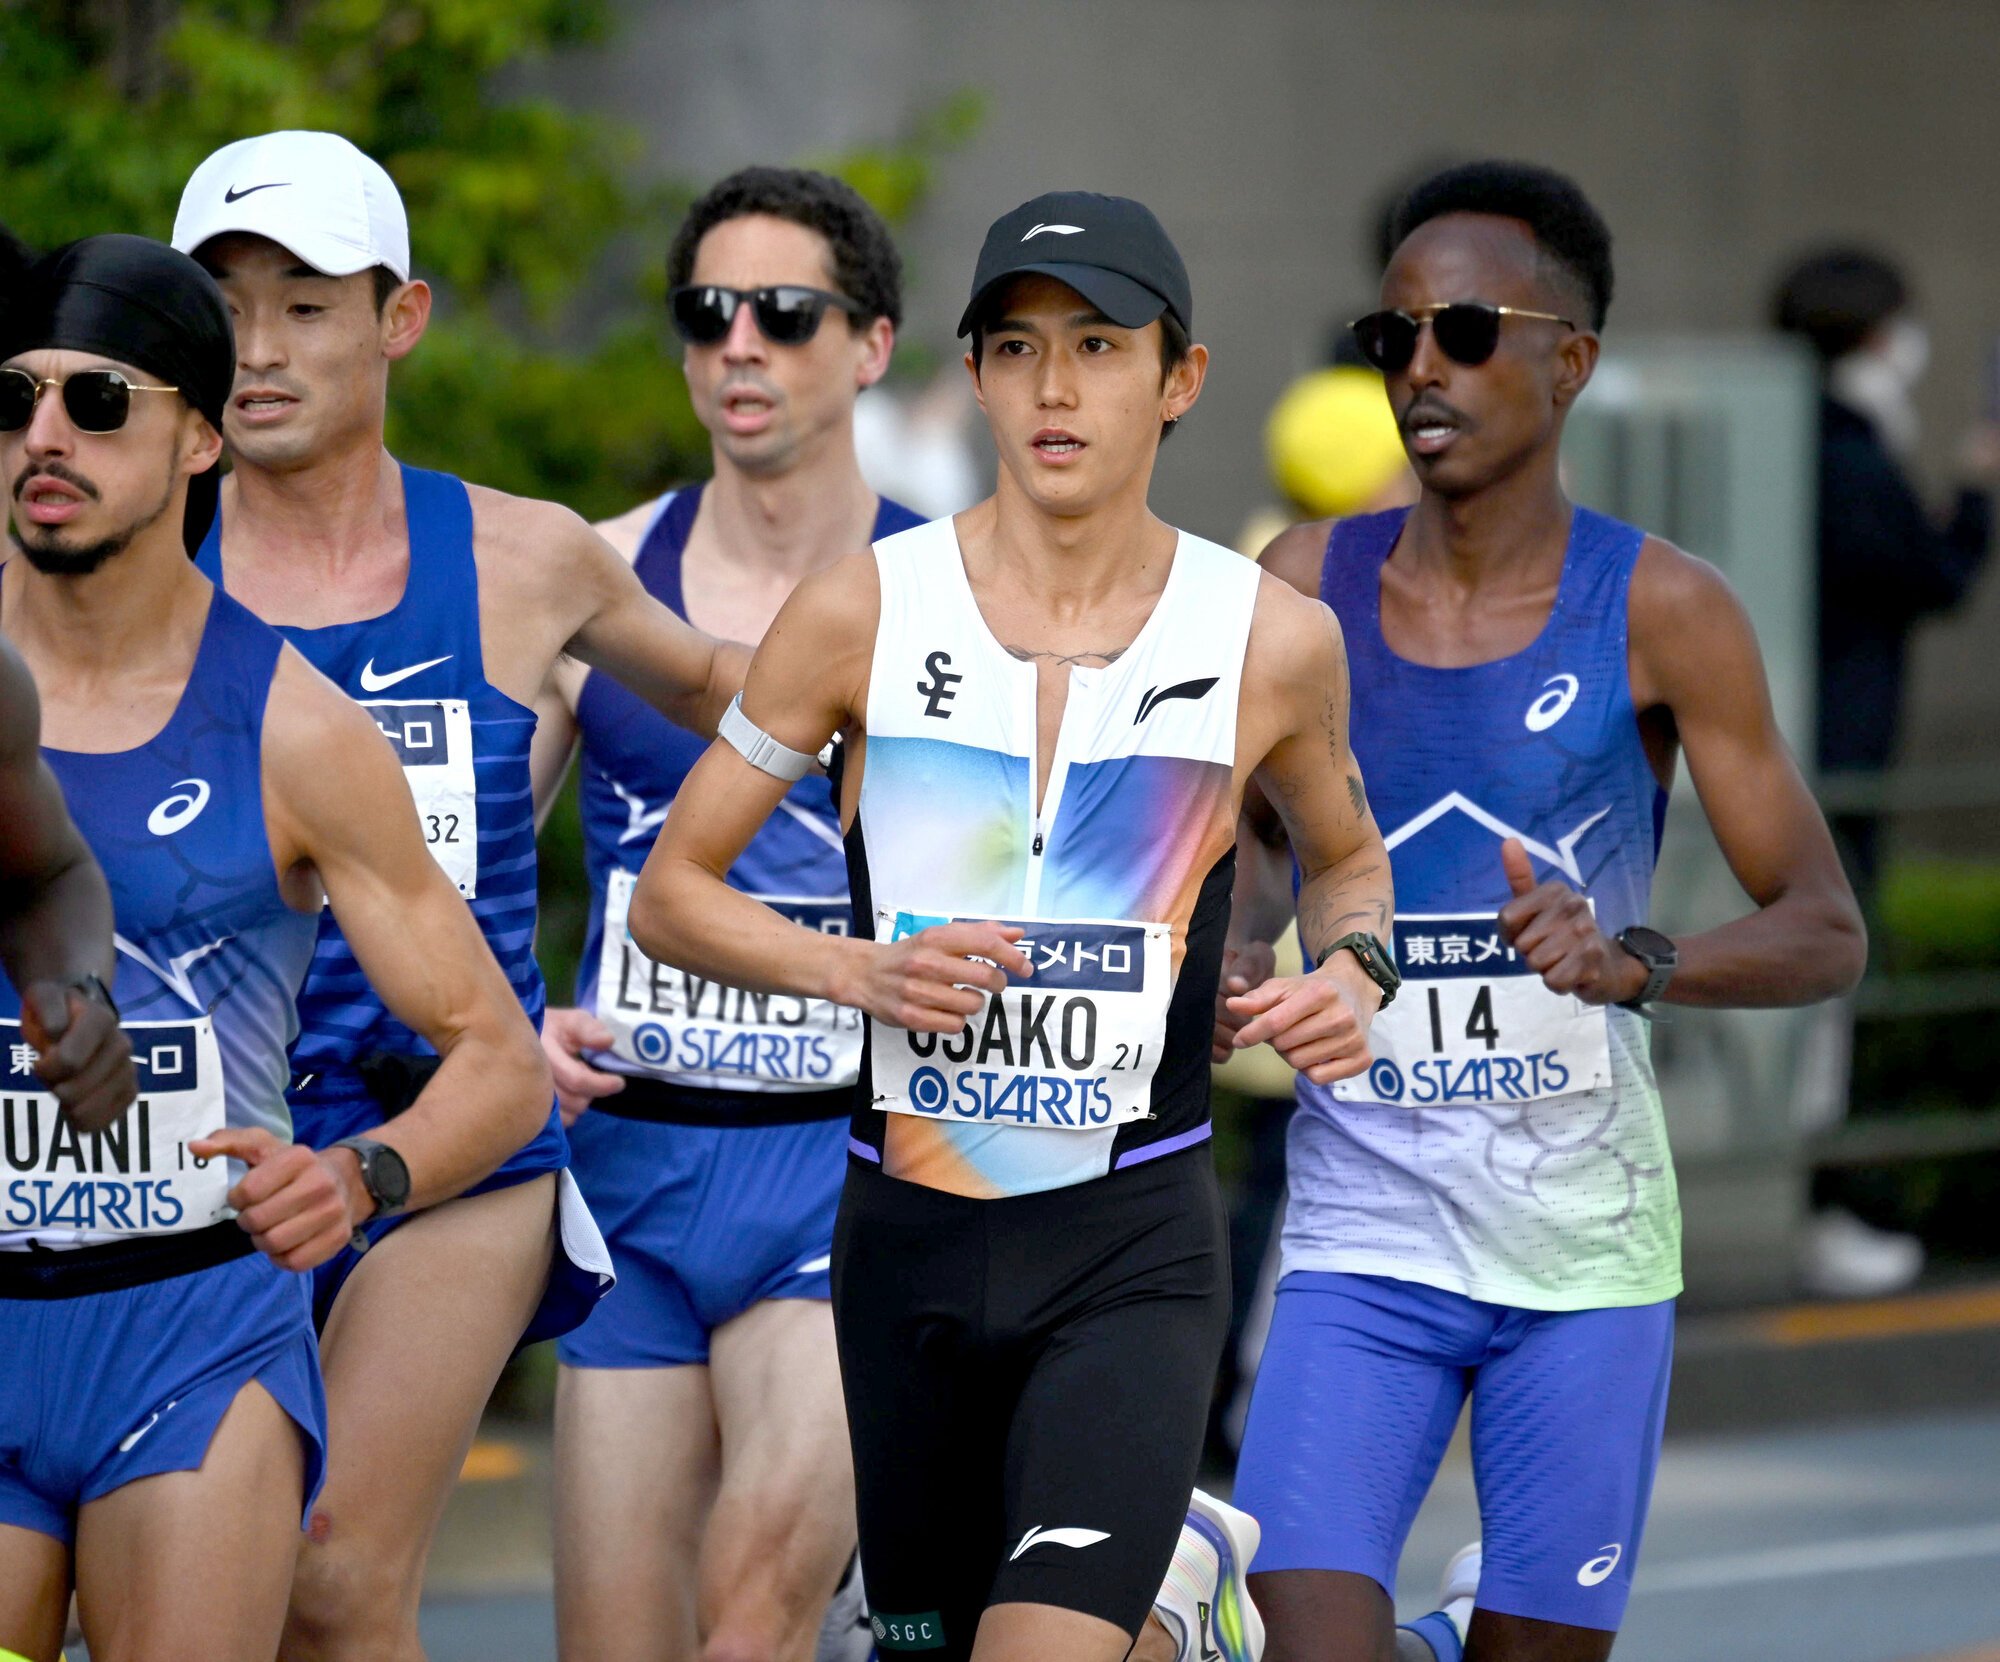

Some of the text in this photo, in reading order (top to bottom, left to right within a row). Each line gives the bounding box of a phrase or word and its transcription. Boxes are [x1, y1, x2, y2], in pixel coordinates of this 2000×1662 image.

[426, 814, 460, 843] 32
[1428, 985, 1499, 1053] 14
[677, 1026, 833, 1080] STARTS
[1111, 1043, 1143, 1071] 21
[1411, 1049, 1569, 1103] STARTS
[952, 1070, 1112, 1126] STARTS
[890, 1623, 932, 1641] SGC
